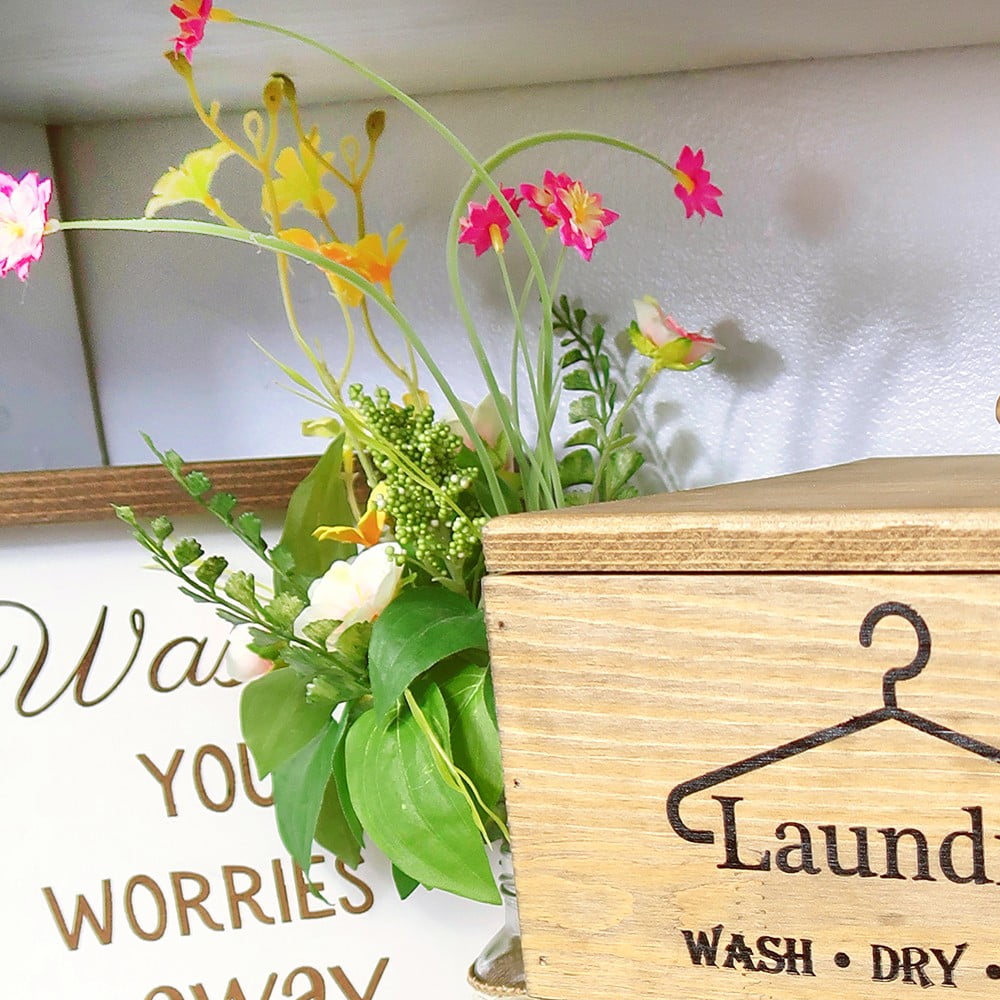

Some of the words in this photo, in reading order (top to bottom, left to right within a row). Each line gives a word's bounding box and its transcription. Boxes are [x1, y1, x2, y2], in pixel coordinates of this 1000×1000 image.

[0, 600, 243, 718] Wa
[136, 742, 275, 817] YOU
[41, 855, 374, 951] WORRIES
[680, 924, 816, 977] WASH
[870, 942, 970, 989] DRY
